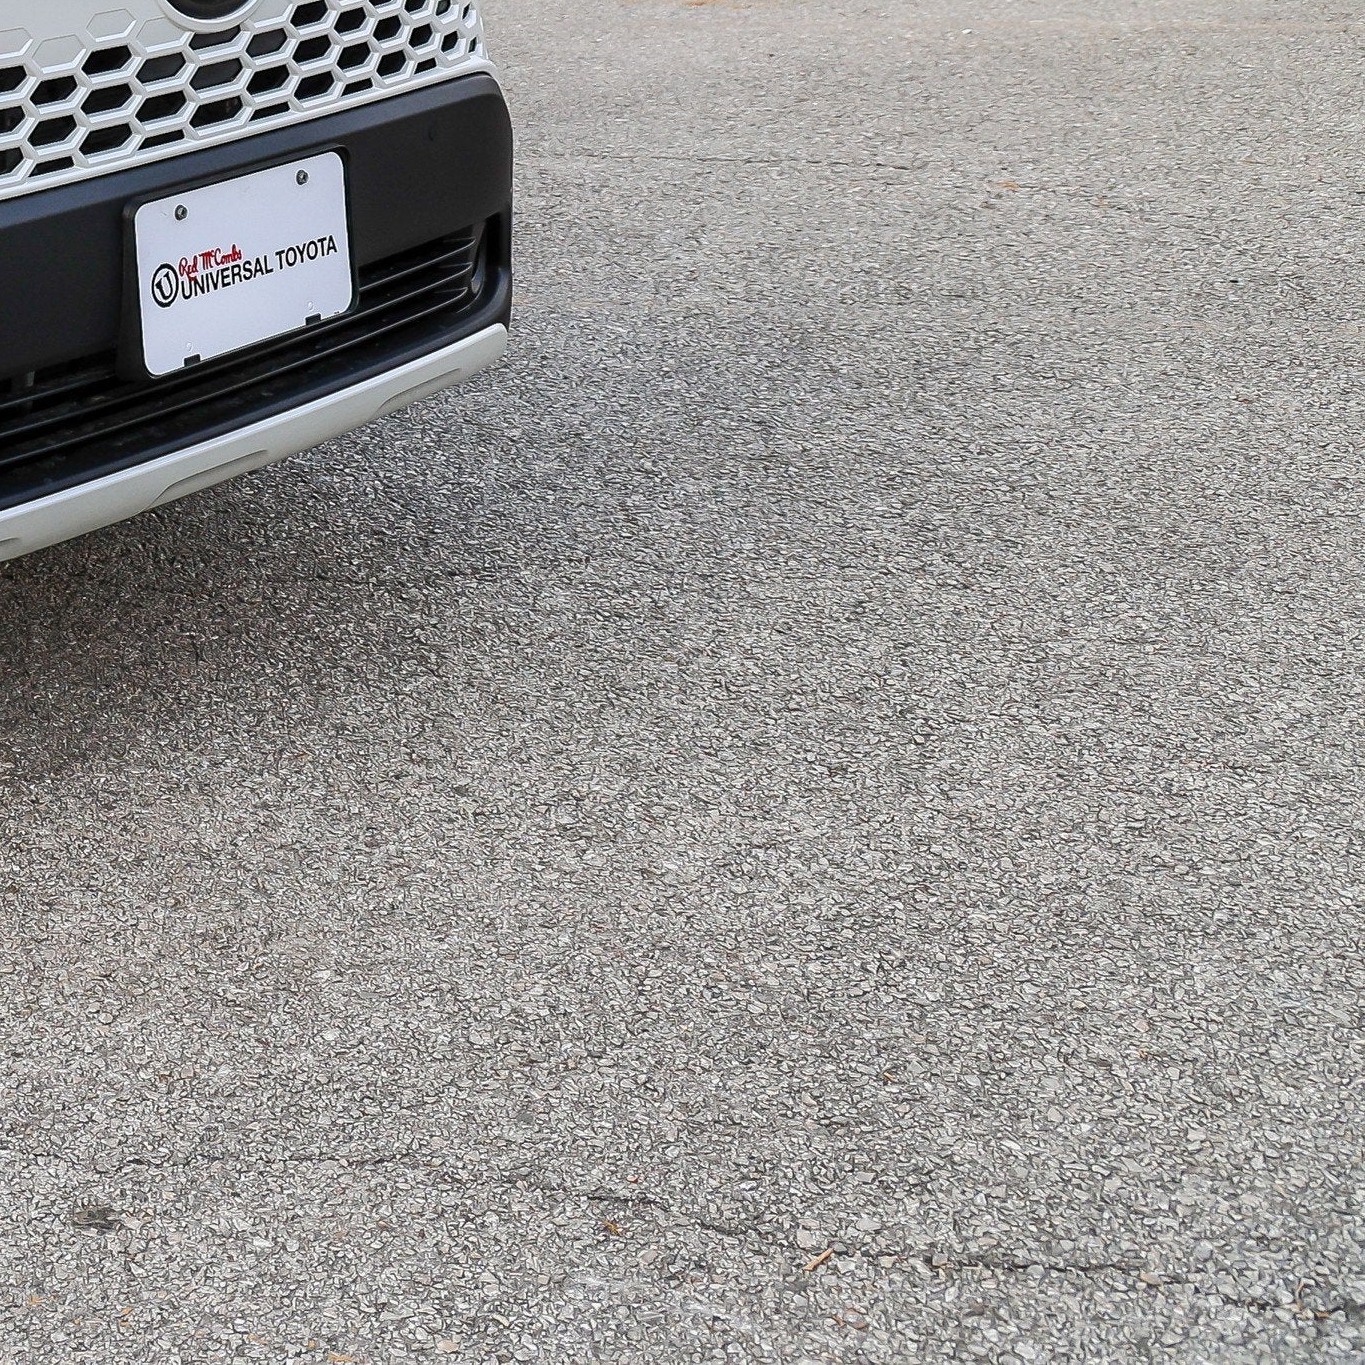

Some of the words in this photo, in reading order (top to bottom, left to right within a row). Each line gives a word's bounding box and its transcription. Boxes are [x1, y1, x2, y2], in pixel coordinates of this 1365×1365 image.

[178, 257, 197, 282] Red
[181, 255, 273, 300] UNIVERSAL
[275, 235, 337, 270] TOYOTA
